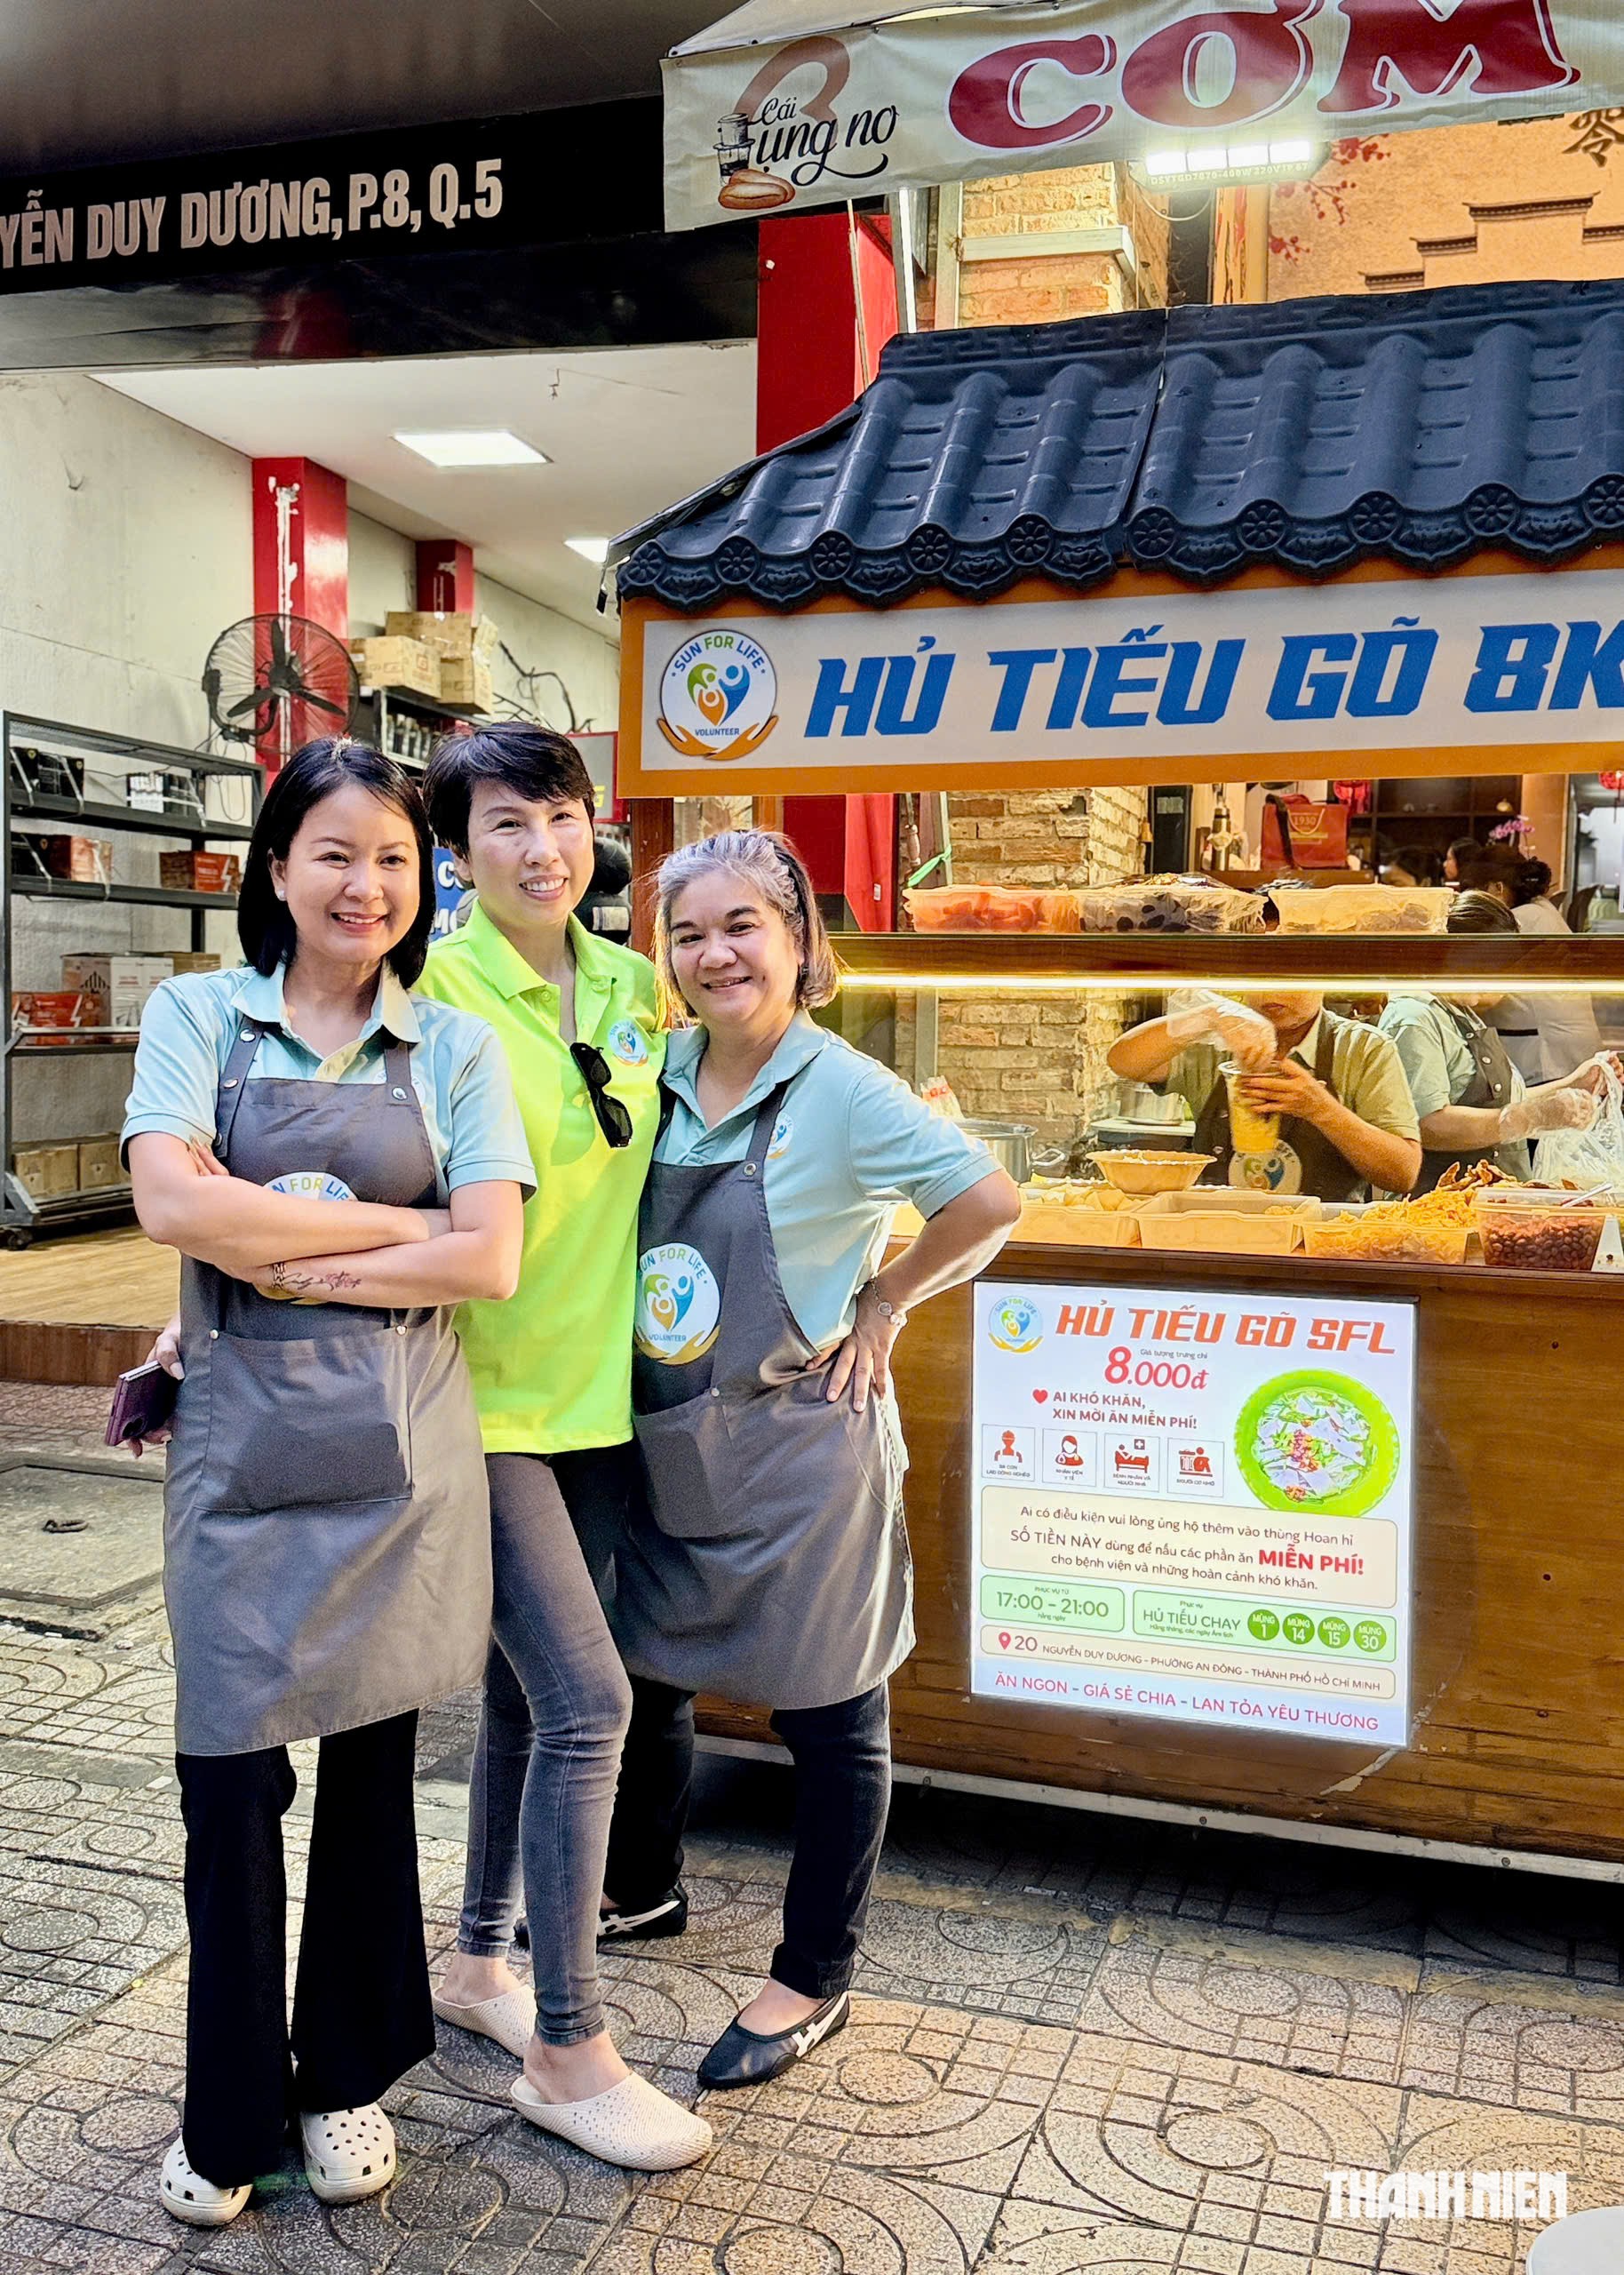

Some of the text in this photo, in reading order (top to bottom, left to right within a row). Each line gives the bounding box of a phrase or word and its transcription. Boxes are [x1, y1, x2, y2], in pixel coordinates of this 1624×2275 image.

[947, 0, 1581, 149] CƠM
[752, 96, 797, 126] Cái
[0, 188, 74, 267] YỄN
[86, 196, 167, 259] DUY
[428, 158, 503, 228] Q.5
[674, 635, 765, 672] SUN FOR LIFE
[804, 616, 1624, 738] HỦ TIẾU GÕ 8K
[695, 727, 740, 737] VOLUNTEER
[290, 1177, 323, 1192] FOR
[659, 1248, 687, 1262] FOR
[688, 1252, 708, 1280] LIFE
[1055, 1299, 1395, 1354] HỦ TIẾU GÕ SFL
[1104, 1346, 1209, 1390] 8.000đ
[1140, 1348, 1152, 1357] Giá
[1053, 1391, 1145, 1409] AI KHÓ KHĂN,
[1053, 1408, 1198, 1429] XIN MỜI ĂN MIỄN PHÍ!
[1021, 1506, 1032, 1516] Ai
[1036, 1508, 1050, 1518] có
[1054, 1506, 1078, 1521] điều
[1081, 1510, 1105, 1524] kiện
[1108, 1514, 1126, 1525] vui
[1129, 1514, 1154, 1529] lòng
[1183, 1521, 1198, 1533] hộ
[1202, 1522, 1234, 1535] thêm
[1238, 1525, 1260, 1537] vào
[1264, 1528, 1300, 1544] thùng
[1304, 1532, 1338, 1545] Hoan
[1010, 1525, 1364, 1576] SỐ TIỀN NÀY dùng để nấu các phần ăn MIỄN PHÍ!
[1051, 1554, 1318, 1590] cho bệnh viện và những hoàn cảnh khó khăn.
[997, 1591, 1109, 1617] 17:00 21:00
[1143, 1607, 1241, 1631] HỦ TIẾU CHAY
[1262, 1624, 1266, 1638] 1
[1292, 1627, 1305, 1642] 14
[1327, 1632, 1341, 1646] 15
[1361, 1635, 1379, 1650] 30
[1015, 1635, 1381, 1691] 20 NGUYỄN DUY DƯƠNG PHƯỜNG AN ĐÔNG THÀNH PHỐ HỒ CHÍ MINH
[995, 1671, 1378, 1730] ĂN NGON GIÁ SẺ CHIA LAN TỎA YÊU THƯƠNG
